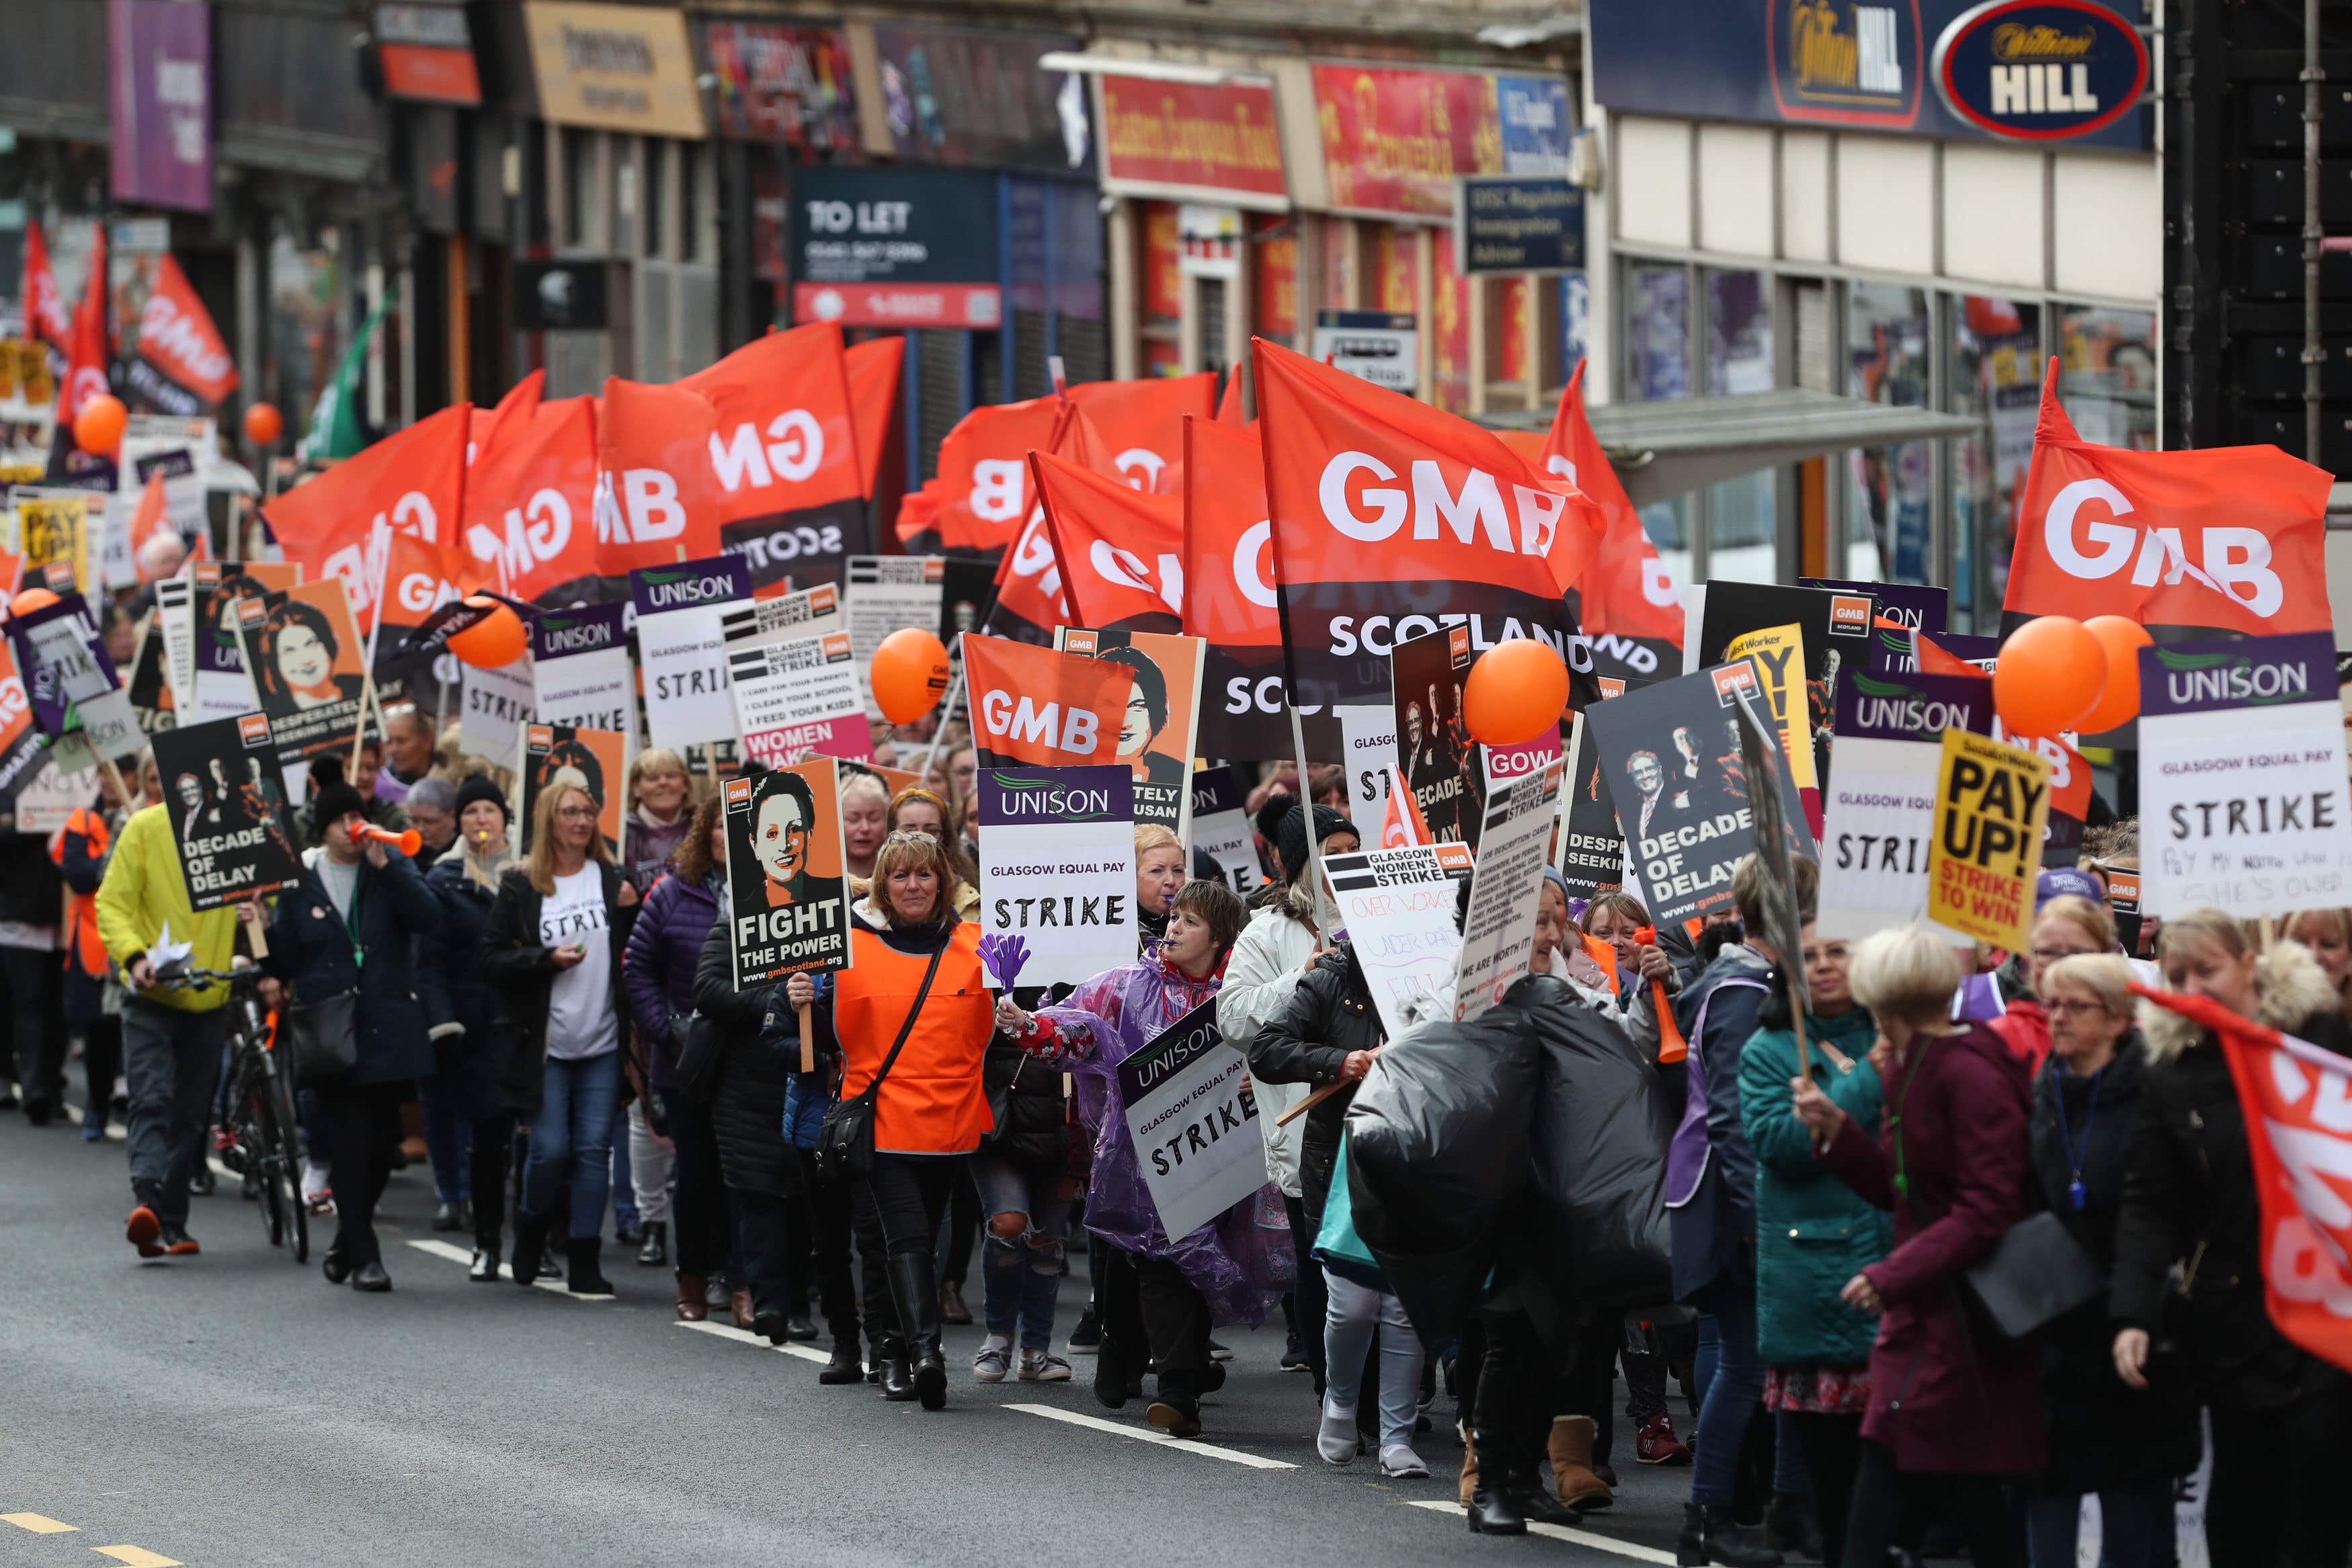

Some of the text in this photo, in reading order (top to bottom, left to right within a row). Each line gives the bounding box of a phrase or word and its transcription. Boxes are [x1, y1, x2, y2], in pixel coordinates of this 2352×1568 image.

[1992, 22, 2097, 62] William
[1991, 63, 2099, 115] HILL
[806, 200, 912, 234] TO LET
[1365, 365, 1406, 383] Stop
[1319, 450, 1566, 559] GMB
[2044, 478, 2284, 618] GMB
[649, 574, 734, 607] UNISON
[758, 595, 807, 614] GLASGOW
[760, 613, 809, 633] STRIKE
[1836, 607, 1864, 620] GMB
[544, 621, 611, 653] UNISON
[766, 638, 819, 654] GLASGOW
[1070, 639, 1092, 650] GMB
[1453, 638, 1467, 652] GMB
[1744, 634, 1781, 649] Worker
[650, 644, 699, 659] GLASGOW
[770, 657, 824, 675] STRIKE
[656, 665, 727, 700] STRI
[786, 692, 812, 704] YOUR
[815, 685, 854, 698] SCHOOL
[1721, 673, 1750, 690] GMB
[2168, 661, 2307, 705] UNISON
[471, 688, 536, 724] STRIK
[549, 708, 624, 732] RIKE
[756, 712, 786, 724] FEED
[789, 705, 823, 718] YOUR
[827, 698, 855, 711] KIDS
[1855, 696, 1970, 733] UNISON
[982, 689, 1099, 755] GMB
[747, 722, 834, 754] WOMEN
[1491, 749, 1554, 774] GOW
[2161, 749, 2333, 776] GLASGOW EQUAL PAY
[729, 788, 748, 800] GMB
[1133, 786, 1178, 802] TELY
[1511, 782, 1544, 806] WOMEN'S
[1512, 772, 1545, 794] GLASGOW
[1949, 757, 2044, 825] PAY
[1002, 788, 1108, 816] UNISON
[1133, 805, 1177, 819] USAN
[1508, 794, 1542, 821] STRIKE
[1839, 792, 1904, 808] GLASGOW
[2170, 790, 2337, 841] STRIKE
[183, 827, 266, 859] DECADE
[1225, 839, 1244, 852] PAY
[1483, 851, 1494, 861] JOB
[1532, 822, 1550, 836] CARER
[1639, 808, 1753, 860] DECADE
[1943, 809, 2031, 878] UP!
[188, 856, 215, 876] OF
[1369, 849, 1433, 863] GLASGOW
[1373, 858, 1438, 874] WOMEN'S
[1442, 854, 1467, 866] GMB
[1646, 852, 1684, 882] OF
[1837, 833, 1931, 874] STRI
[191, 864, 256, 893] DELAY
[991, 862, 1125, 877] GLASGOW EQUAL PAY
[1377, 869, 1443, 887] STRIKE
[1652, 856, 1746, 903] DELAY
[1941, 858, 2025, 904] STRIKE
[2109, 883, 2136, 897] GMB
[995, 895, 1125, 930] STRIKE
[1352, 894, 1397, 918] OVER
[1939, 882, 1966, 910] TO
[1971, 896, 2021, 930] WIN
[738, 898, 841, 947] FIGHT
[1469, 919, 1486, 933] PHONE
[740, 933, 842, 968] THE POWER
[1462, 935, 1532, 979] WE ARE WORTH IT!
[743, 955, 843, 983] www.gmbscotland.org
[1460, 960, 1528, 1000] www.gmbscotland.org
[1137, 1022, 1221, 1087] UNISON
[1140, 1058, 1245, 1135] GLASGOW EQUAL PAY
[1151, 1091, 1259, 1177] STRIKE
